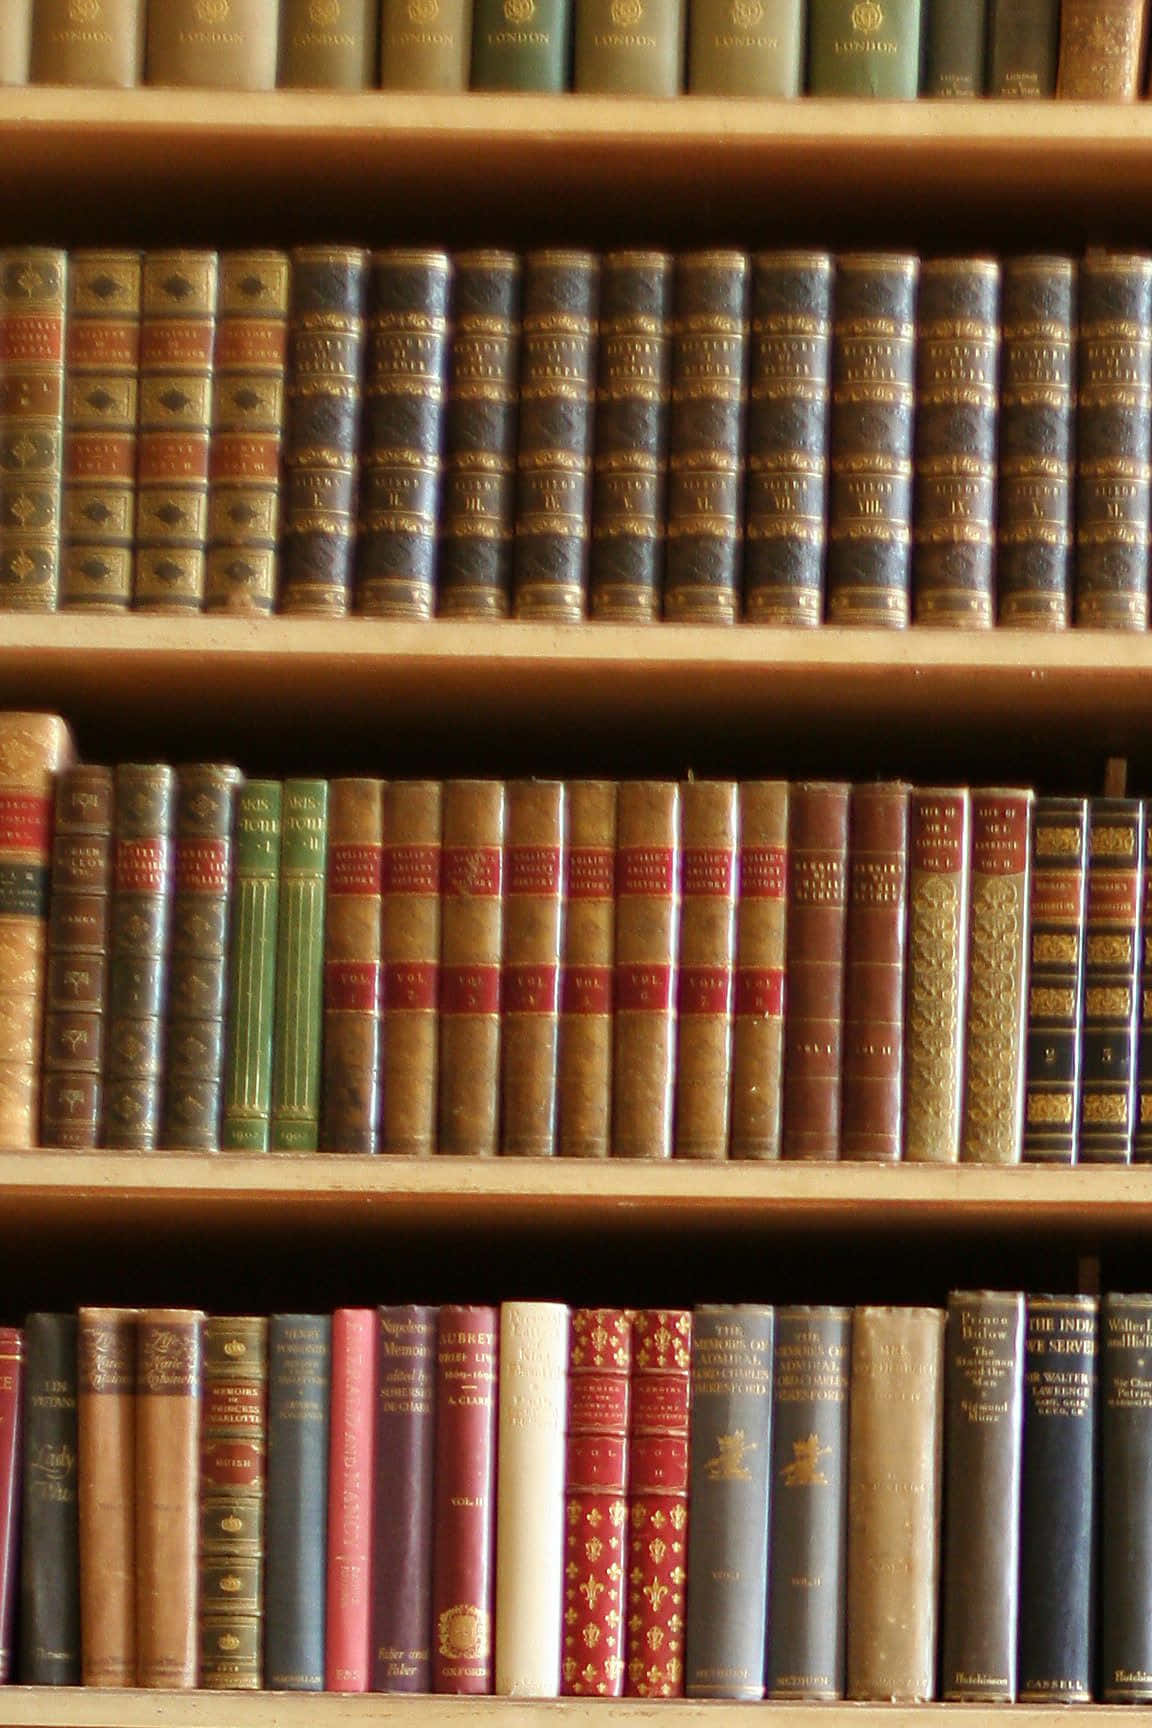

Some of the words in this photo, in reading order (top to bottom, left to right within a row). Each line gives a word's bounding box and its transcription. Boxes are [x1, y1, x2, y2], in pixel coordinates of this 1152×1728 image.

[487, 33, 550, 46] LONDON
[594, 33, 658, 47] LONDON
[714, 34, 780, 48] LONDON
[833, 40, 899, 54] LONDON
[714, 1324, 745, 1337] THE
[1028, 1318, 1055, 1332] THE
[1108, 1318, 1143, 1333] Walter
[954, 1671, 1008, 1686] Hutchinson
[1026, 1678, 1082, 1692] CASSELL
